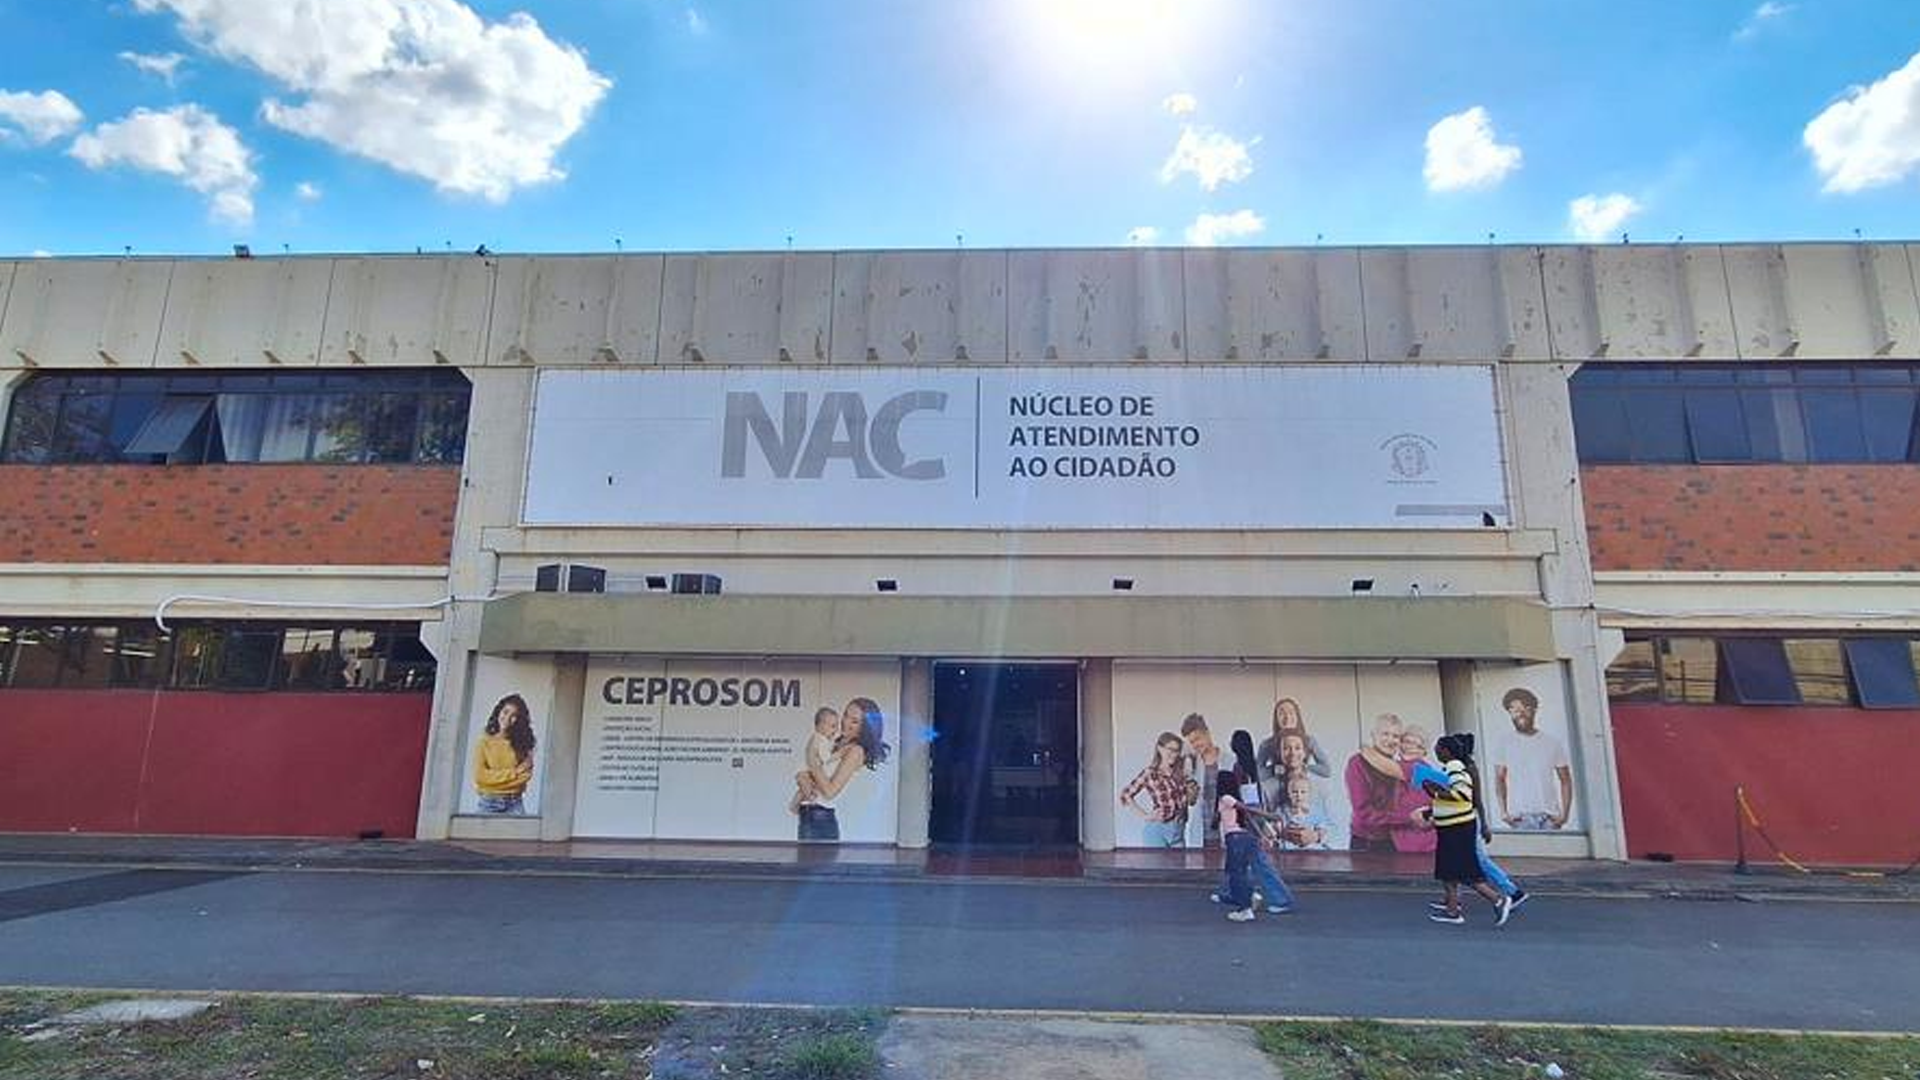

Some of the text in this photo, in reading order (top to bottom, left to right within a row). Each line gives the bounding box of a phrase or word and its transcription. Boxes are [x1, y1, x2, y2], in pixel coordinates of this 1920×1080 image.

[1010, 392, 1154, 416] NÚCLEO DE
[722, 391, 948, 480] NAC
[1010, 427, 1200, 447] ATENDIMENTO
[1010, 452, 1176, 477] AO CIDADÃO
[603, 677, 800, 706] CEPROSOM
